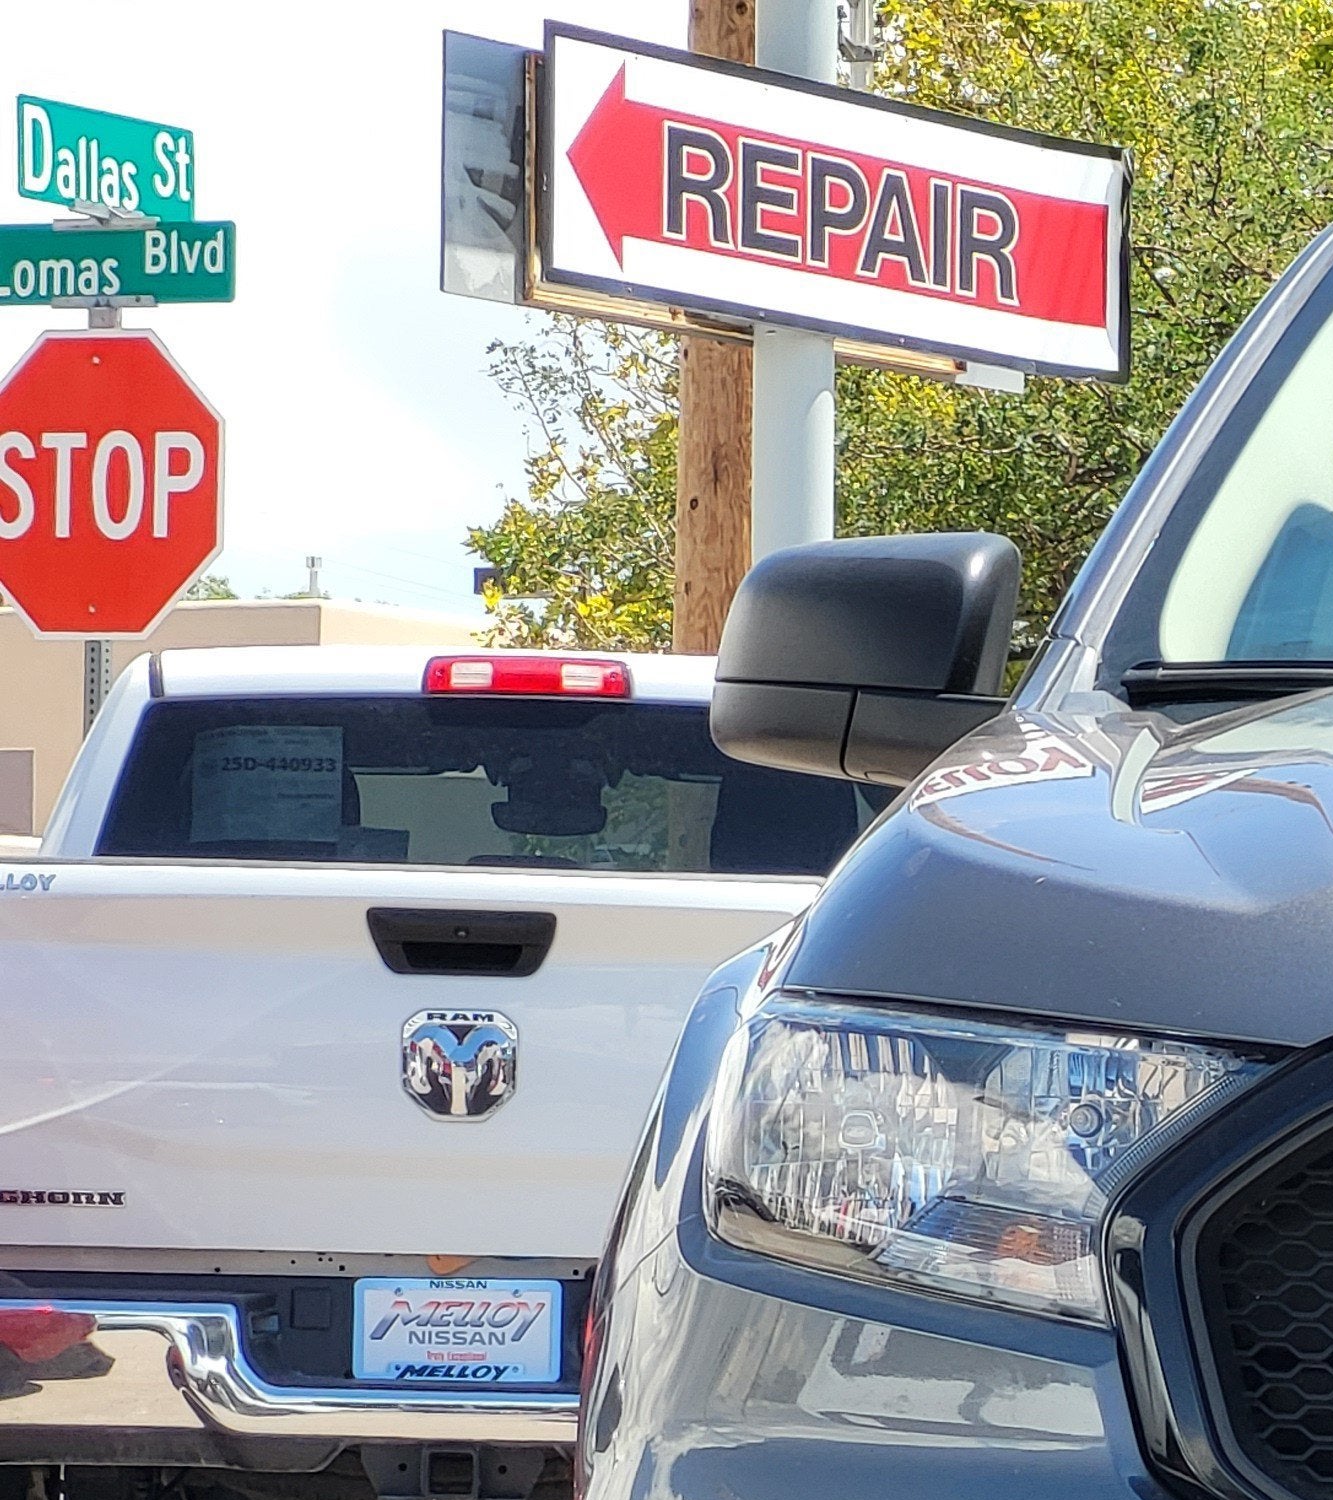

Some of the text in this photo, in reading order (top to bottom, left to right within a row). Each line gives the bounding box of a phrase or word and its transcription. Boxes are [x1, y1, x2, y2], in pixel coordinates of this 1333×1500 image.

[22, 103, 191, 211] Dallas St
[662, 118, 1020, 305] REPAIR
[145, 229, 225, 273] Blvd
[0, 431, 205, 540] STOP
[0, 873, 57, 891] LOY
[427, 1012, 494, 1022] RAM
[429, 1280, 487, 1290] NISSAN
[370, 1300, 546, 1342] MELLOY
[408, 1330, 506, 1346] NISSAN
[398, 1364, 508, 1381] MELLOY
